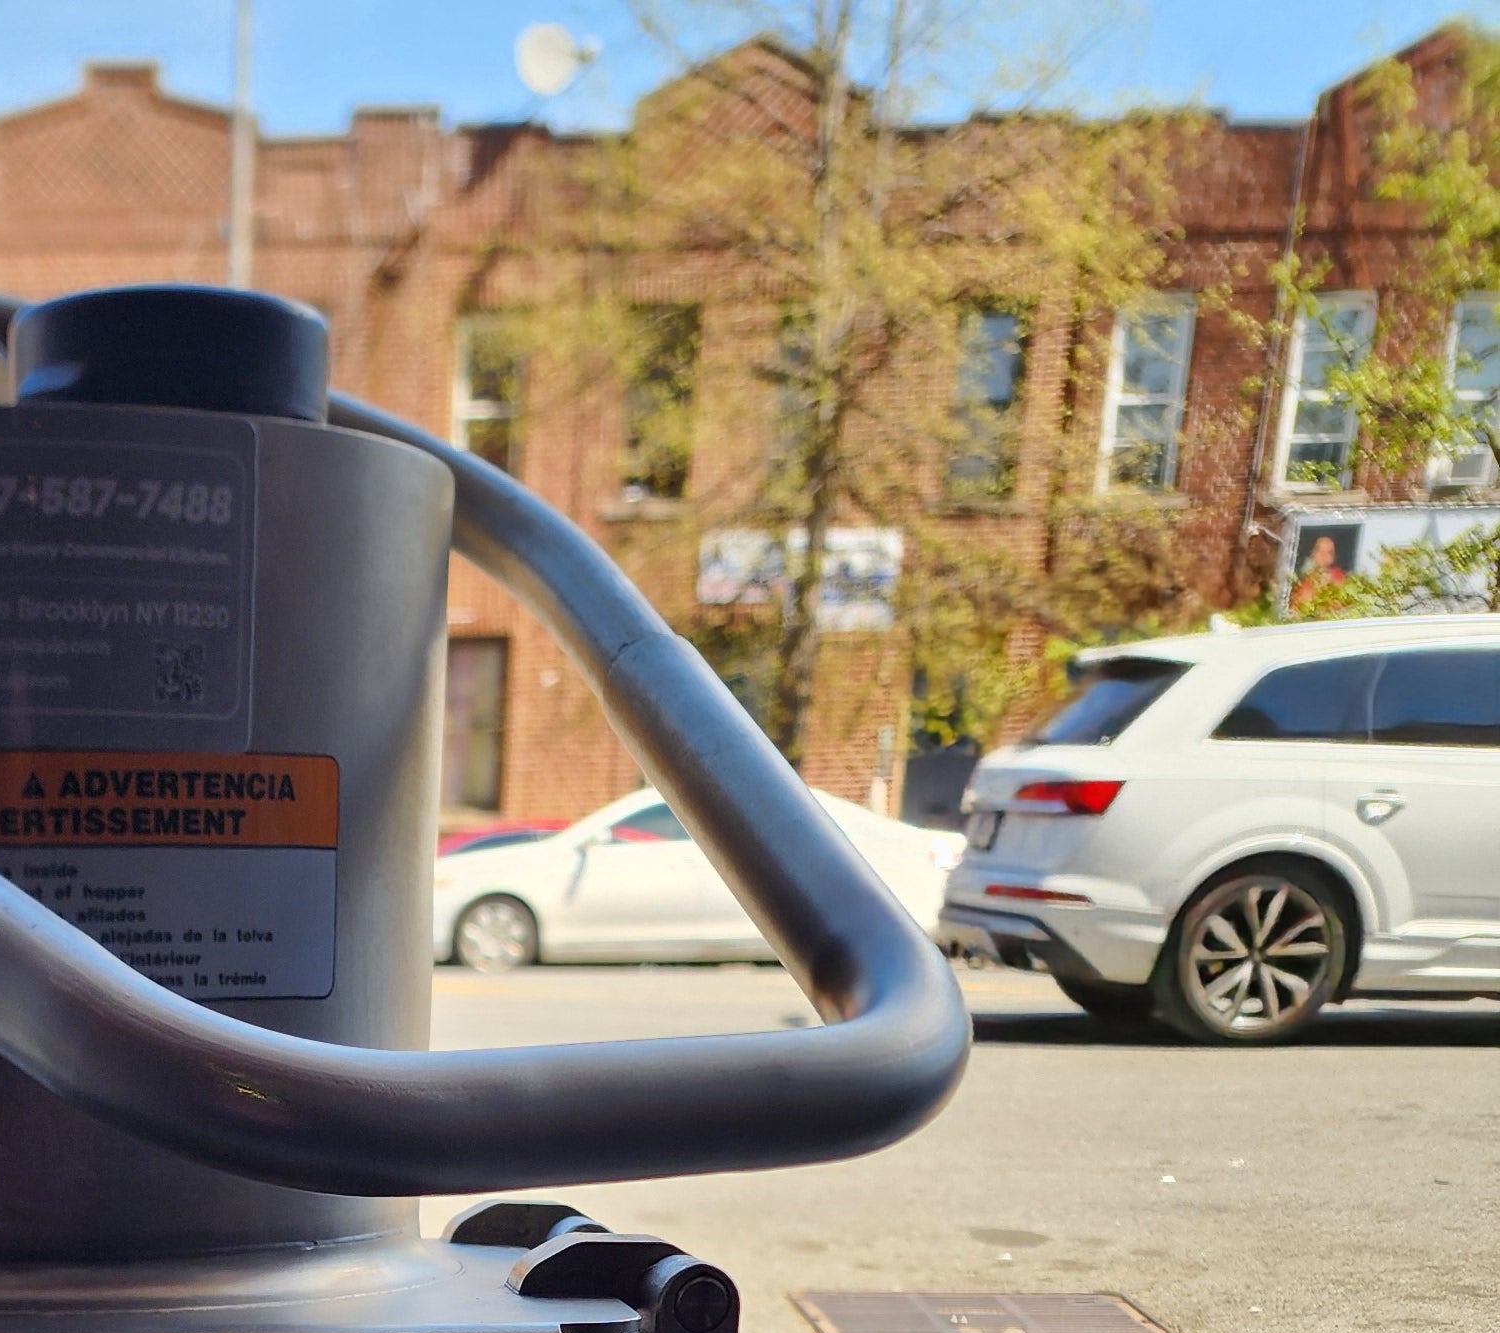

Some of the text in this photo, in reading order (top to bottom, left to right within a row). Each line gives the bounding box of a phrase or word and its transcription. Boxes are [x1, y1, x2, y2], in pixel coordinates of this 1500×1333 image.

[17, 595, 129, 630] Brooklyn
[136, 601, 169, 625] NY
[173, 602, 231, 629] 11230
[58, 770, 297, 803] ADVERTENCIA
[23, 863, 78, 879] inside
[83, 885, 145, 902] hopper
[183, 929, 203, 943] de
[213, 929, 227, 943] la
[237, 929, 274, 943] tolva
[194, 973, 208, 987] la
